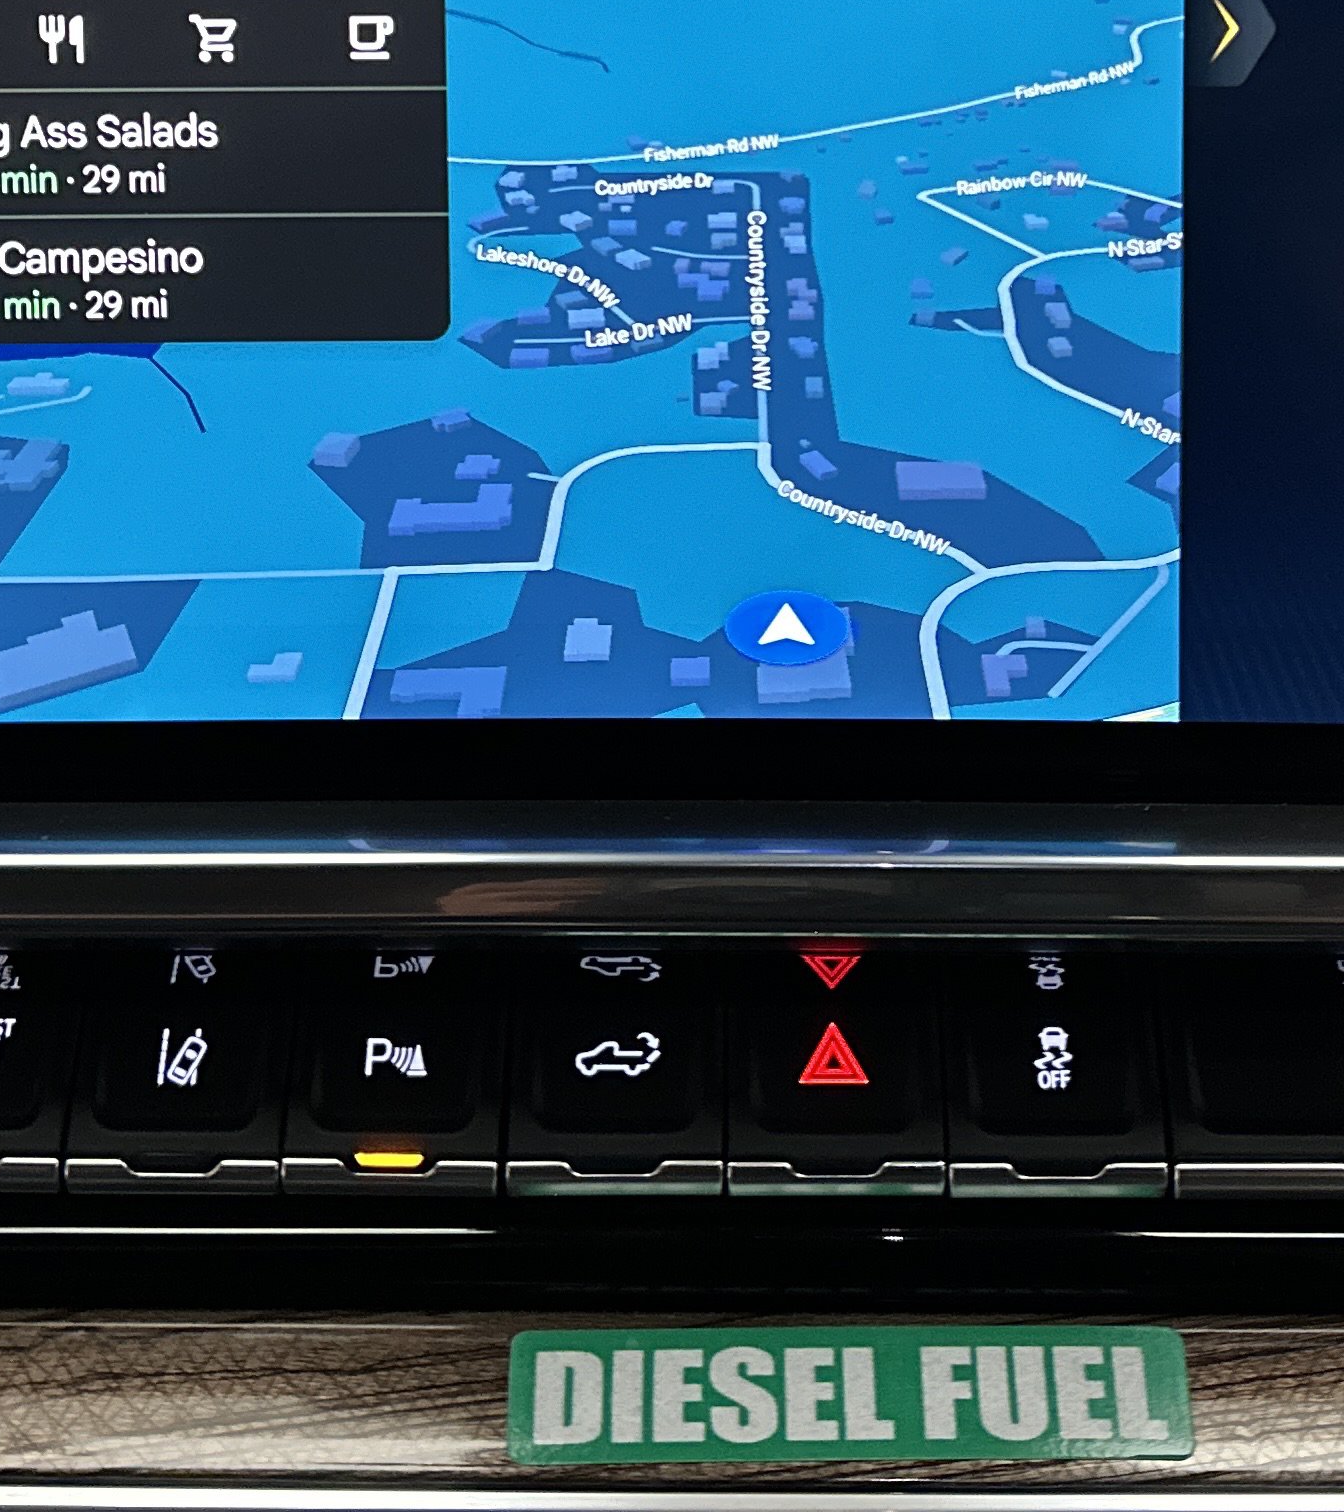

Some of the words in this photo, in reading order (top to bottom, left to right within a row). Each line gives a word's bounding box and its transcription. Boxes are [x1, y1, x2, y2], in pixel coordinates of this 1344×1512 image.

[1014, 76, 1087, 100] Fisherman
[1088, 68, 1109, 86] Rd
[1109, 60, 1135, 80] NW
[20, 114, 88, 149] Ass
[97, 111, 219, 149] Salads
[643, 142, 725, 163] Fisherman
[726, 136, 749, 154] Rd
[750, 133, 779, 151] NW
[1, 163, 58, 194] min
[82, 164, 121, 193] 29
[128, 162, 166, 193] mi
[594, 172, 693, 196] Countryside
[694, 172, 714, 189] Dr
[956, 176, 1027, 196] Rainbow
[1030, 170, 1054, 188] Cir
[1056, 170, 1088, 188] NW
[1107, 240, 1124, 258] N
[1126, 237, 1163, 256] Star
[1166, 231, 1184, 250] S
[475, 244, 568, 278] Lakeshore
[567, 265, 591, 288] Dr
[586, 278, 621, 309] NW
[745, 211, 770, 326] Countryside
[4, 289, 61, 320] min
[85, 290, 123, 319] 29
[131, 288, 168, 319] mi
[585, 328, 630, 348] Lake
[632, 322, 656, 342] Dr
[658, 313, 693, 336] NW
[751, 330, 771, 353] Dr
[752, 356, 773, 392] NW
[1120, 407, 1141, 429] N
[1140, 416, 1182, 445] Star
[777, 479, 886, 534] Countryside
[887, 520, 913, 542] Dr
[912, 529, 952, 556] NW
[1036, 1069, 1072, 1090] OFF
[532, 1345, 897, 1446] DIESEL
[920, 1344, 1171, 1442] FUEL
